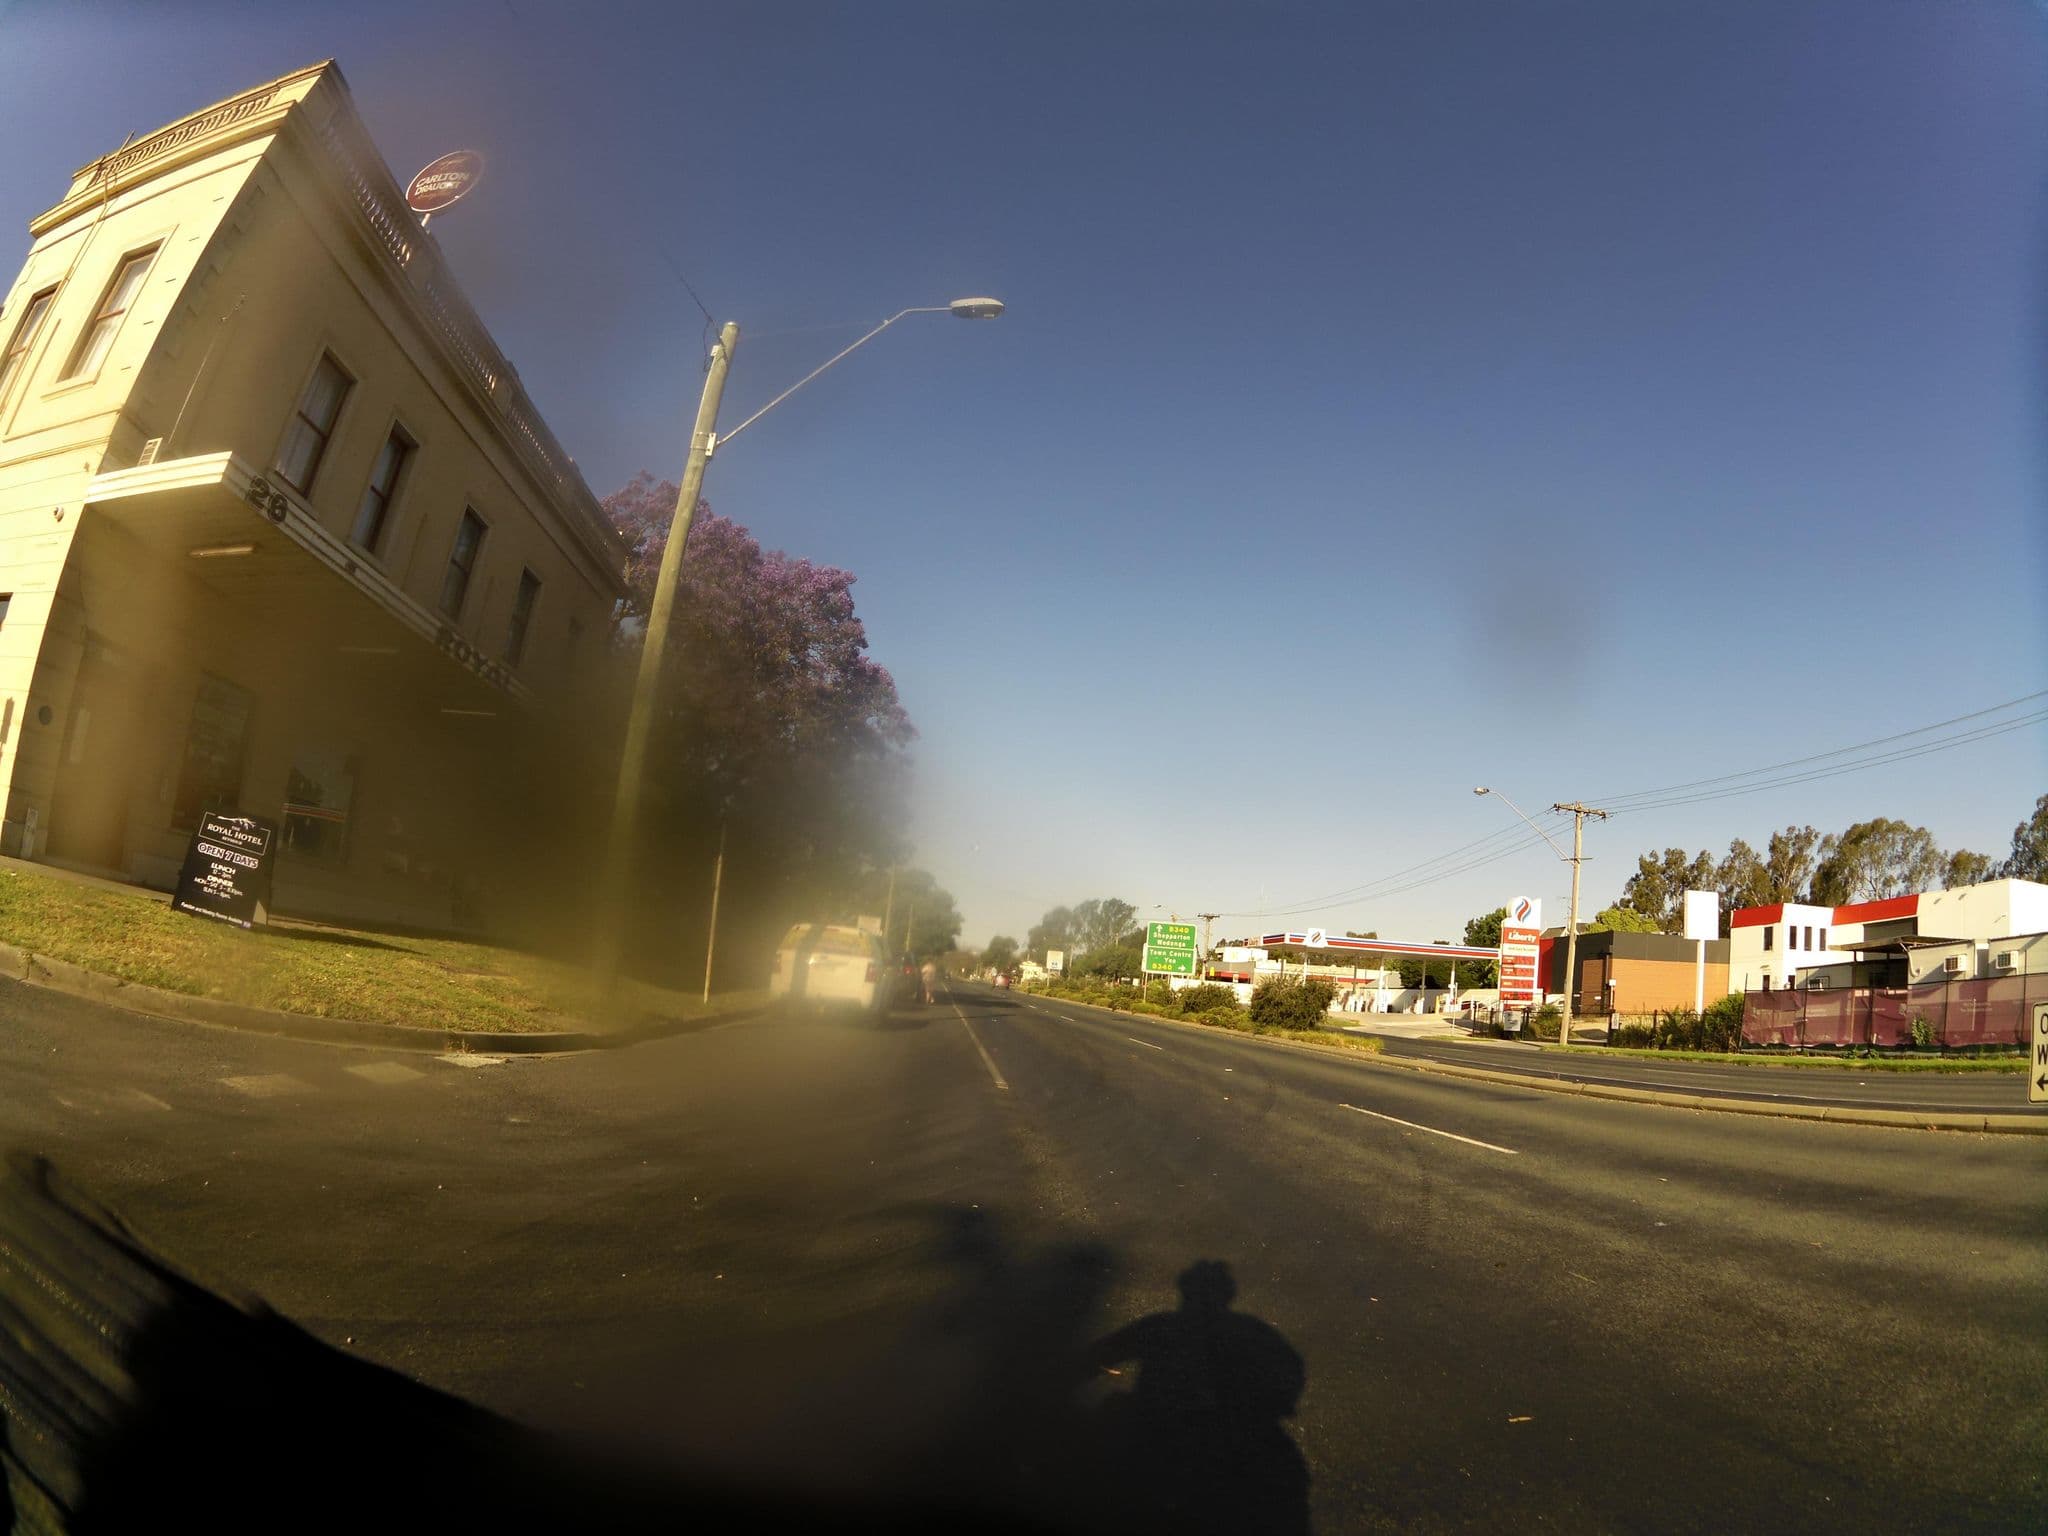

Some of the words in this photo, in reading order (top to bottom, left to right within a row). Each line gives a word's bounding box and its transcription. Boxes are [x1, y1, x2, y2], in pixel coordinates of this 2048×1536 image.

[415, 172, 470, 188] CARLTON
[207, 823, 233, 837] ROYAL
[234, 831, 263, 846] HOTEL
[197, 842, 225, 859] OPEN
[224, 850, 234, 861] 7
[232, 853, 259, 869] DAYS
[210, 862, 236, 875] LUNCH
[206, 874, 234, 888] DINNER
[1153, 932, 1191, 940] Shepparton
[1508, 930, 1537, 943] Liberty
